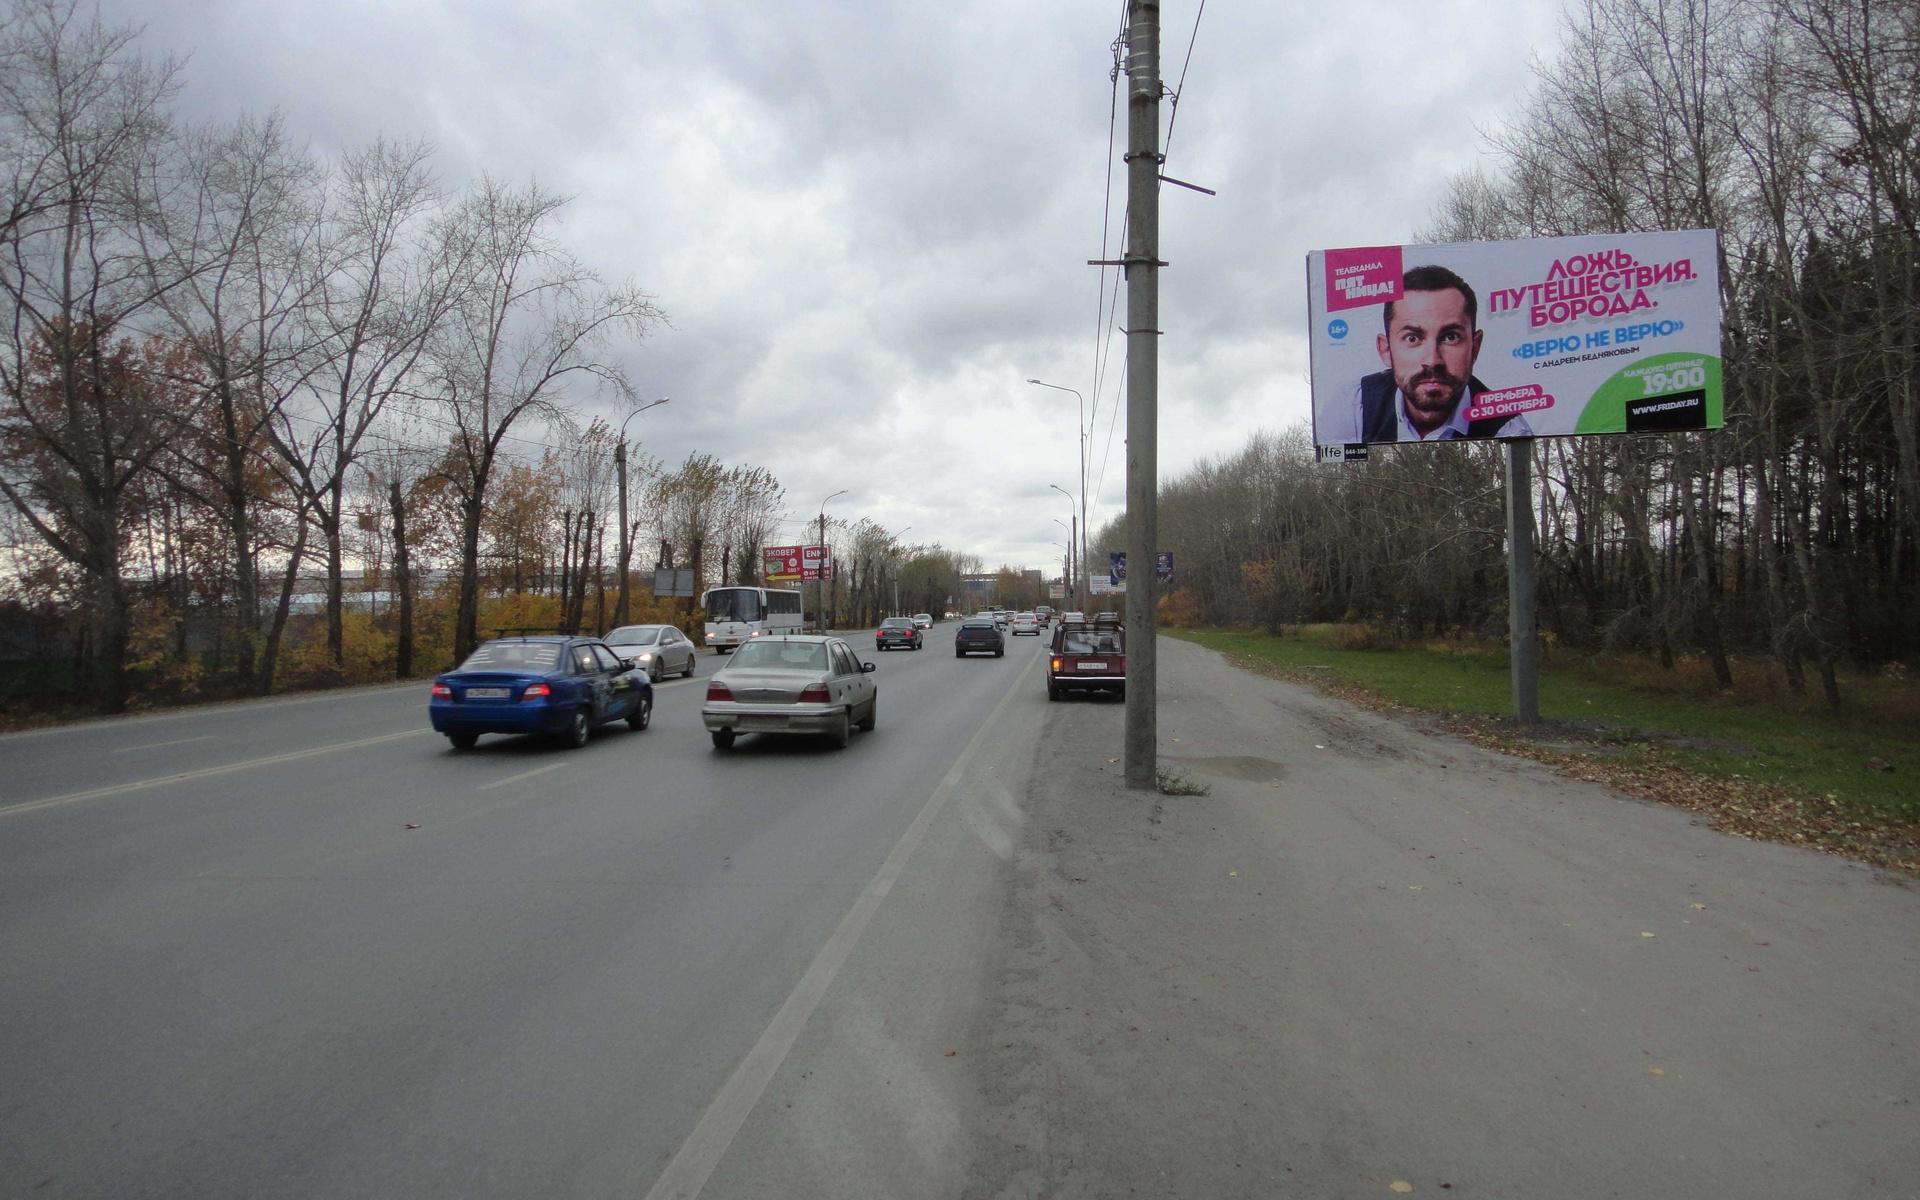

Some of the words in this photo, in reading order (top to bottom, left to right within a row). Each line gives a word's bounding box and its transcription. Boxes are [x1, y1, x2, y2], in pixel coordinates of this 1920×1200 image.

[1335, 262, 1383, 276] ТЕЛЕКАНАЛ
[1547, 249, 1638, 281] ЛОЖЬ.
[1335, 275, 1365, 290] ПЯТ
[1345, 281, 1394, 300] НИЦА!
[1490, 259, 1698, 313] ПУТЕШЕСТВИЯ.
[1530, 289, 1658, 328] БОРОДА.
[1512, 335, 1581, 359] «ВЕРЮ
[1585, 330, 1610, 349] НЕ
[1615, 320, 1685, 343] ВЕРЮ»
[1542, 356, 1580, 369] АНДРЕЕМ
[1582, 346, 1640, 361] БЕДНЯКОВЫМ
[1643, 367, 1705, 395] 19:00
[1480, 387, 1536, 404] ПРЕМЬЕРА
[1632, 398, 1699, 415] WWW.FRIDAY.RU
[1470, 408, 1479, 418] С
[1481, 406, 1494, 416] 30
[1496, 397, 1547, 414] ОКТЯБРЯ
